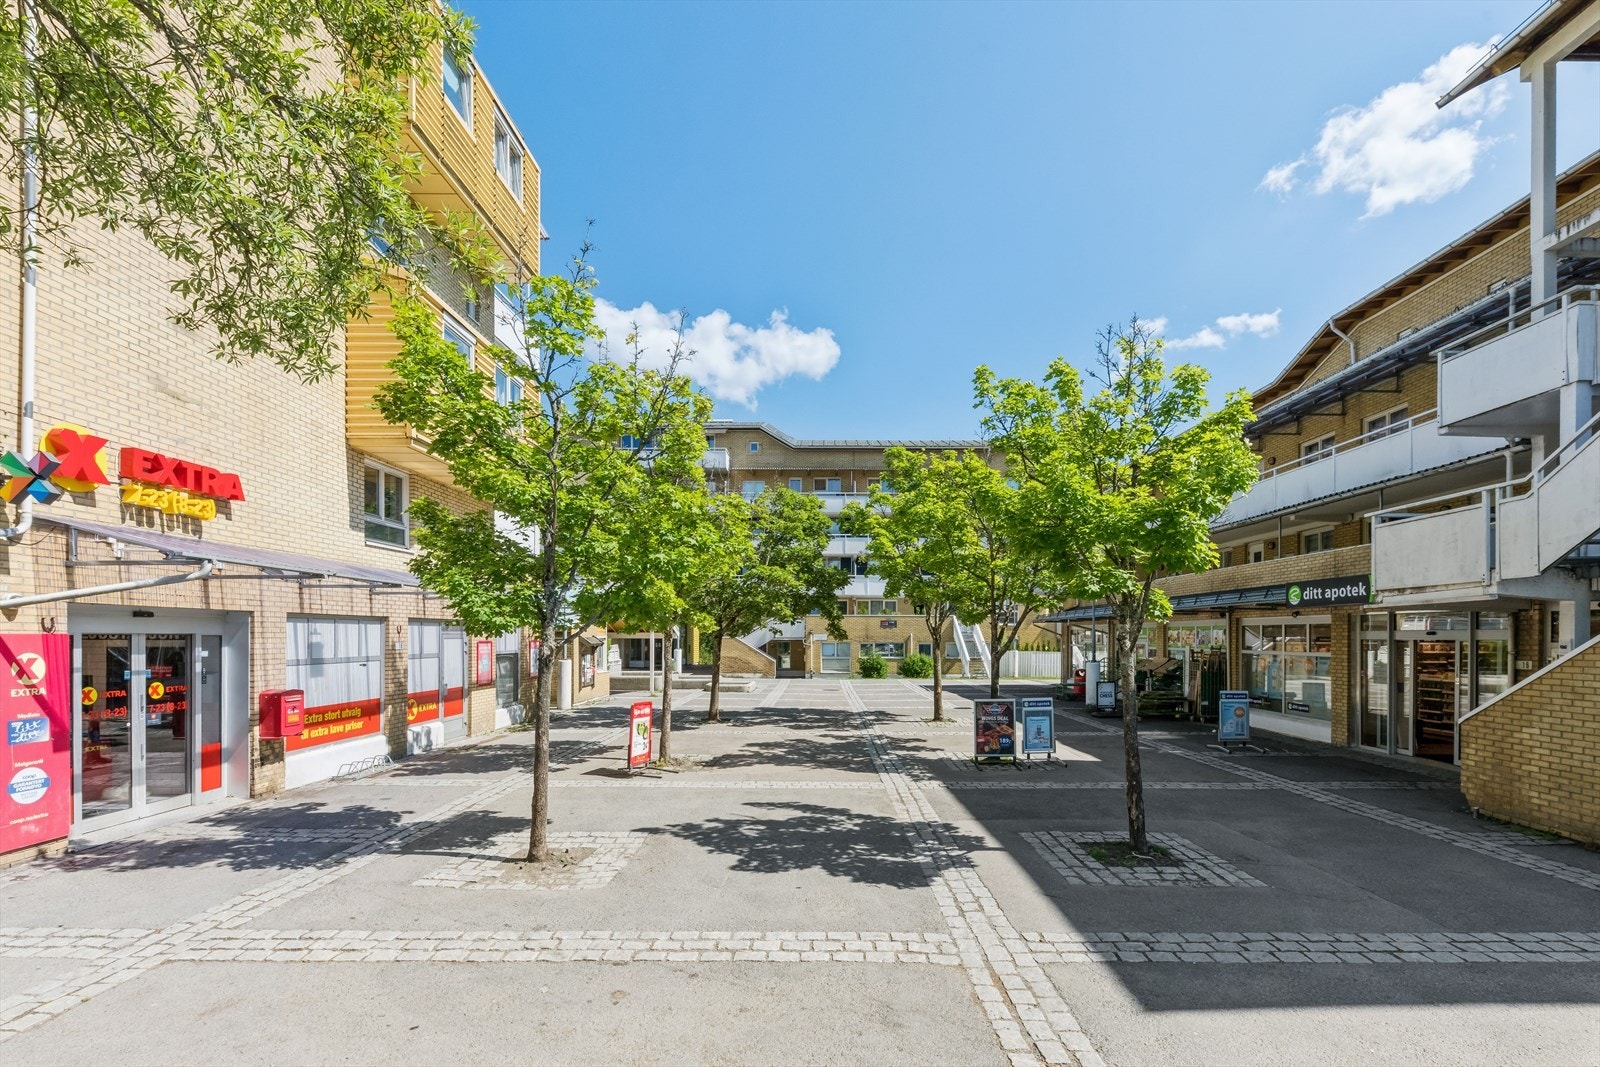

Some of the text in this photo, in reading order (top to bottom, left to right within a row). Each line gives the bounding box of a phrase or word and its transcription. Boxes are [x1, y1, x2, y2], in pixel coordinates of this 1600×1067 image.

[120, 447, 245, 501] EXTRA
[120, 484, 217, 520] 7-23 (8-23)
[1303, 582, 1367, 601] ditt apotek
[10, 687, 47, 697] EXTRA
[99, 689, 127, 698] EXTRA
[304, 713, 323, 725] Extra
[324, 710, 341, 721] stort
[342, 707, 361, 718] utvalg
[310, 727, 329, 738] extra
[330, 724, 344, 734] lave
[345, 720, 364, 733] priser
